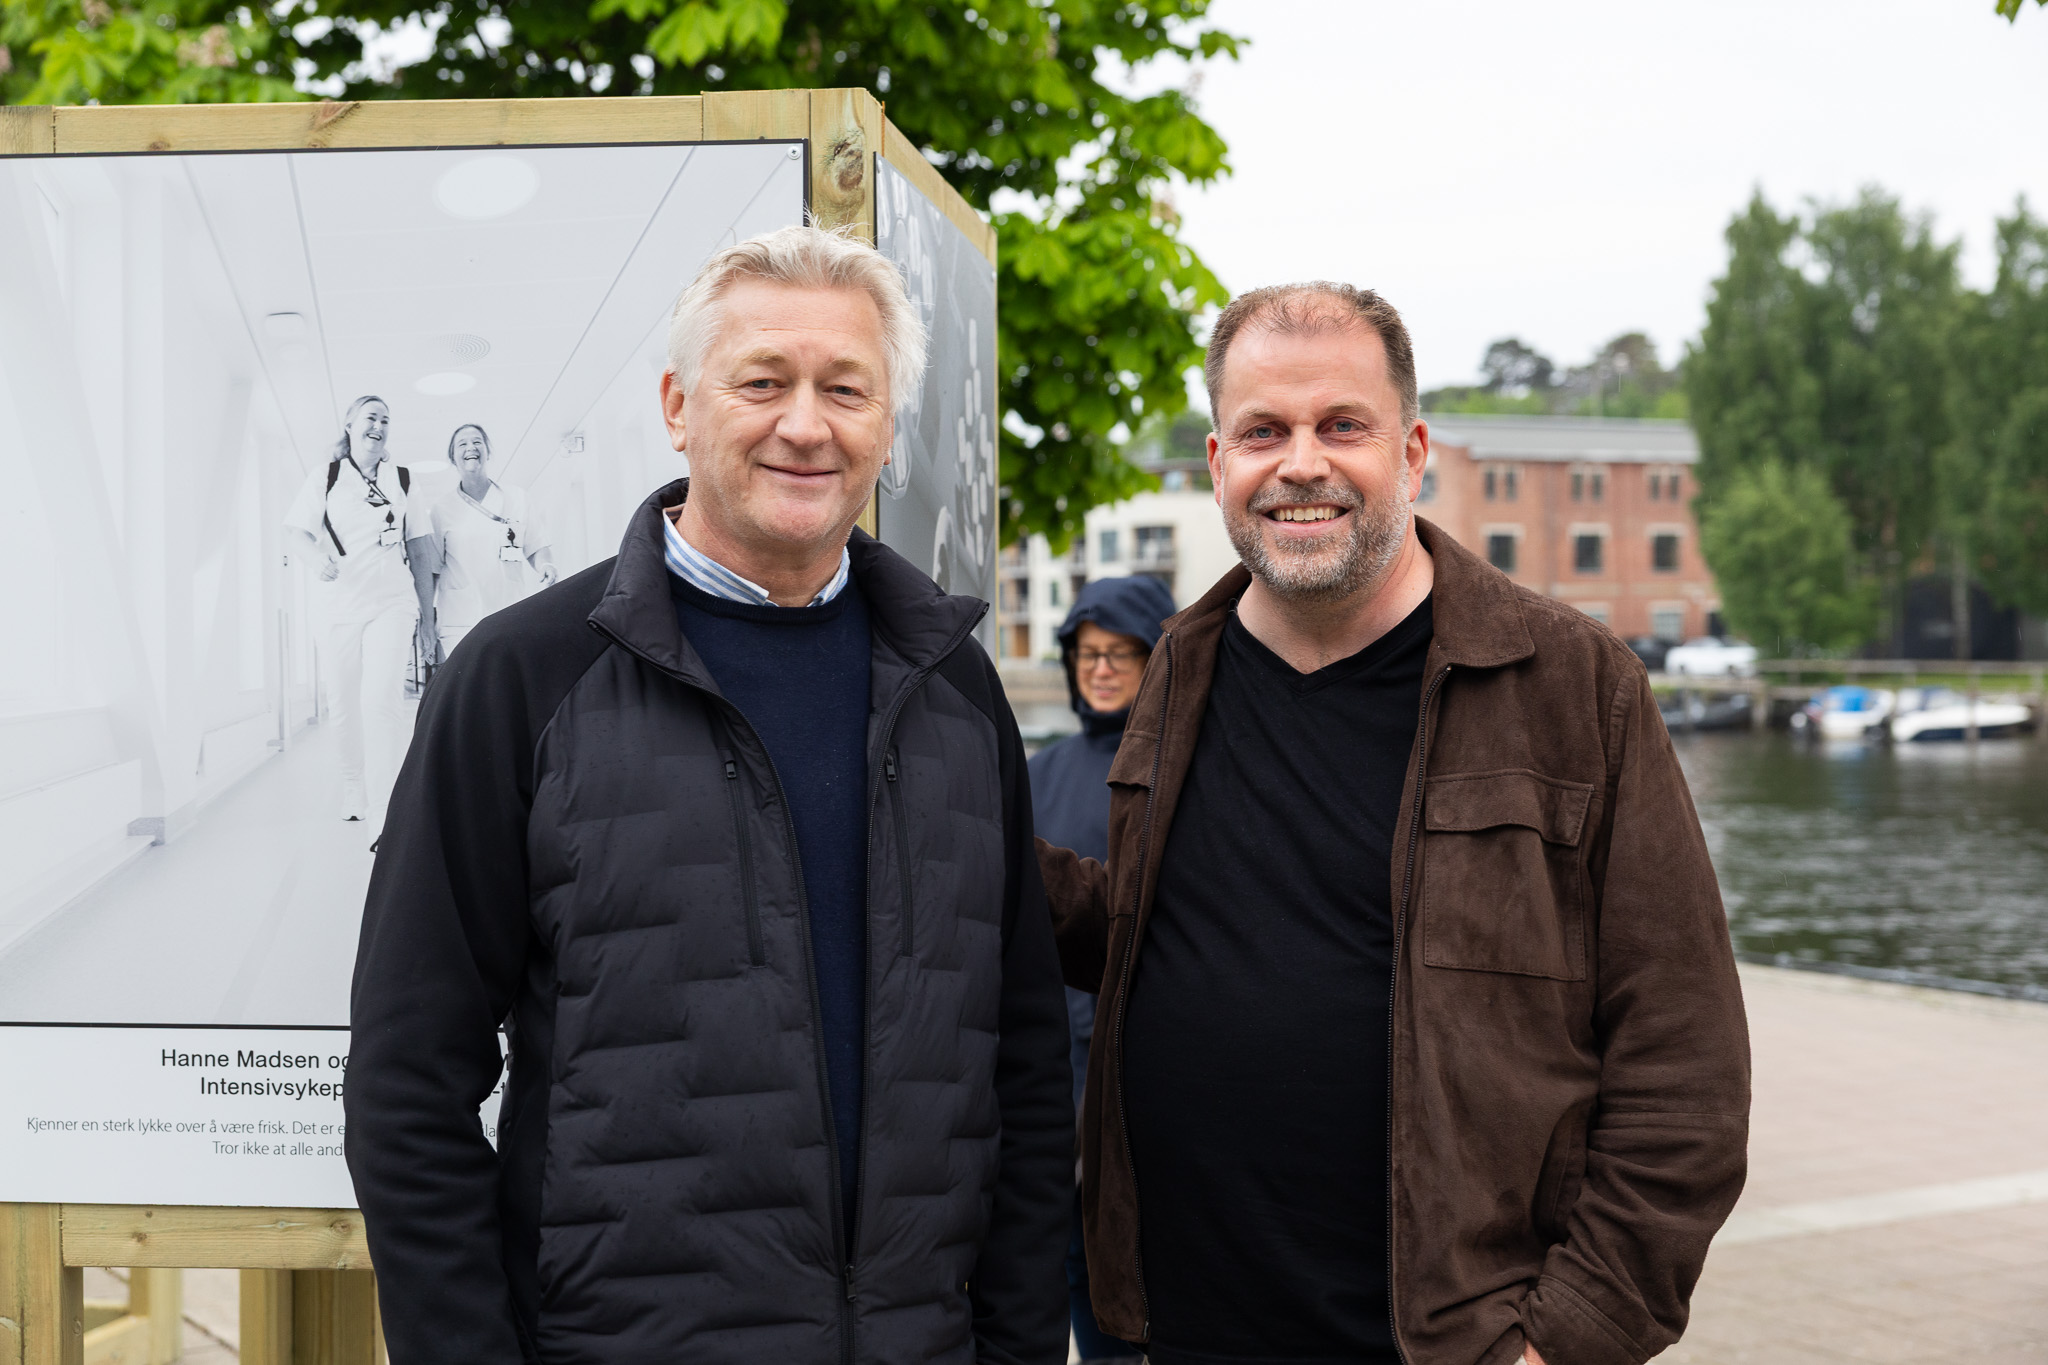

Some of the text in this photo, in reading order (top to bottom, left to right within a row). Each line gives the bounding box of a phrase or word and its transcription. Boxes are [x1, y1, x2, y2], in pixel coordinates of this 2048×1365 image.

[161, 1048, 230, 1068] Hanne
[237, 1049, 320, 1069] Madsen
[27, 1117, 78, 1134] Kjenner
[82, 1121, 99, 1132] en
[103, 1118, 135, 1133] sterk
[138, 1118, 173, 1136] lykke
[176, 1122, 206, 1133] over
[209, 1119, 217, 1133] å
[220, 1123, 255, 1134] være
[258, 1119, 289, 1135] frisk.
[292, 1120, 317, 1135] Det
[320, 1124, 335, 1135] er
[212, 1140, 240, 1155] Tror
[243, 1140, 270, 1156] ikke
[273, 1143, 287, 1156] at
[289, 1142, 314, 1156] alle
